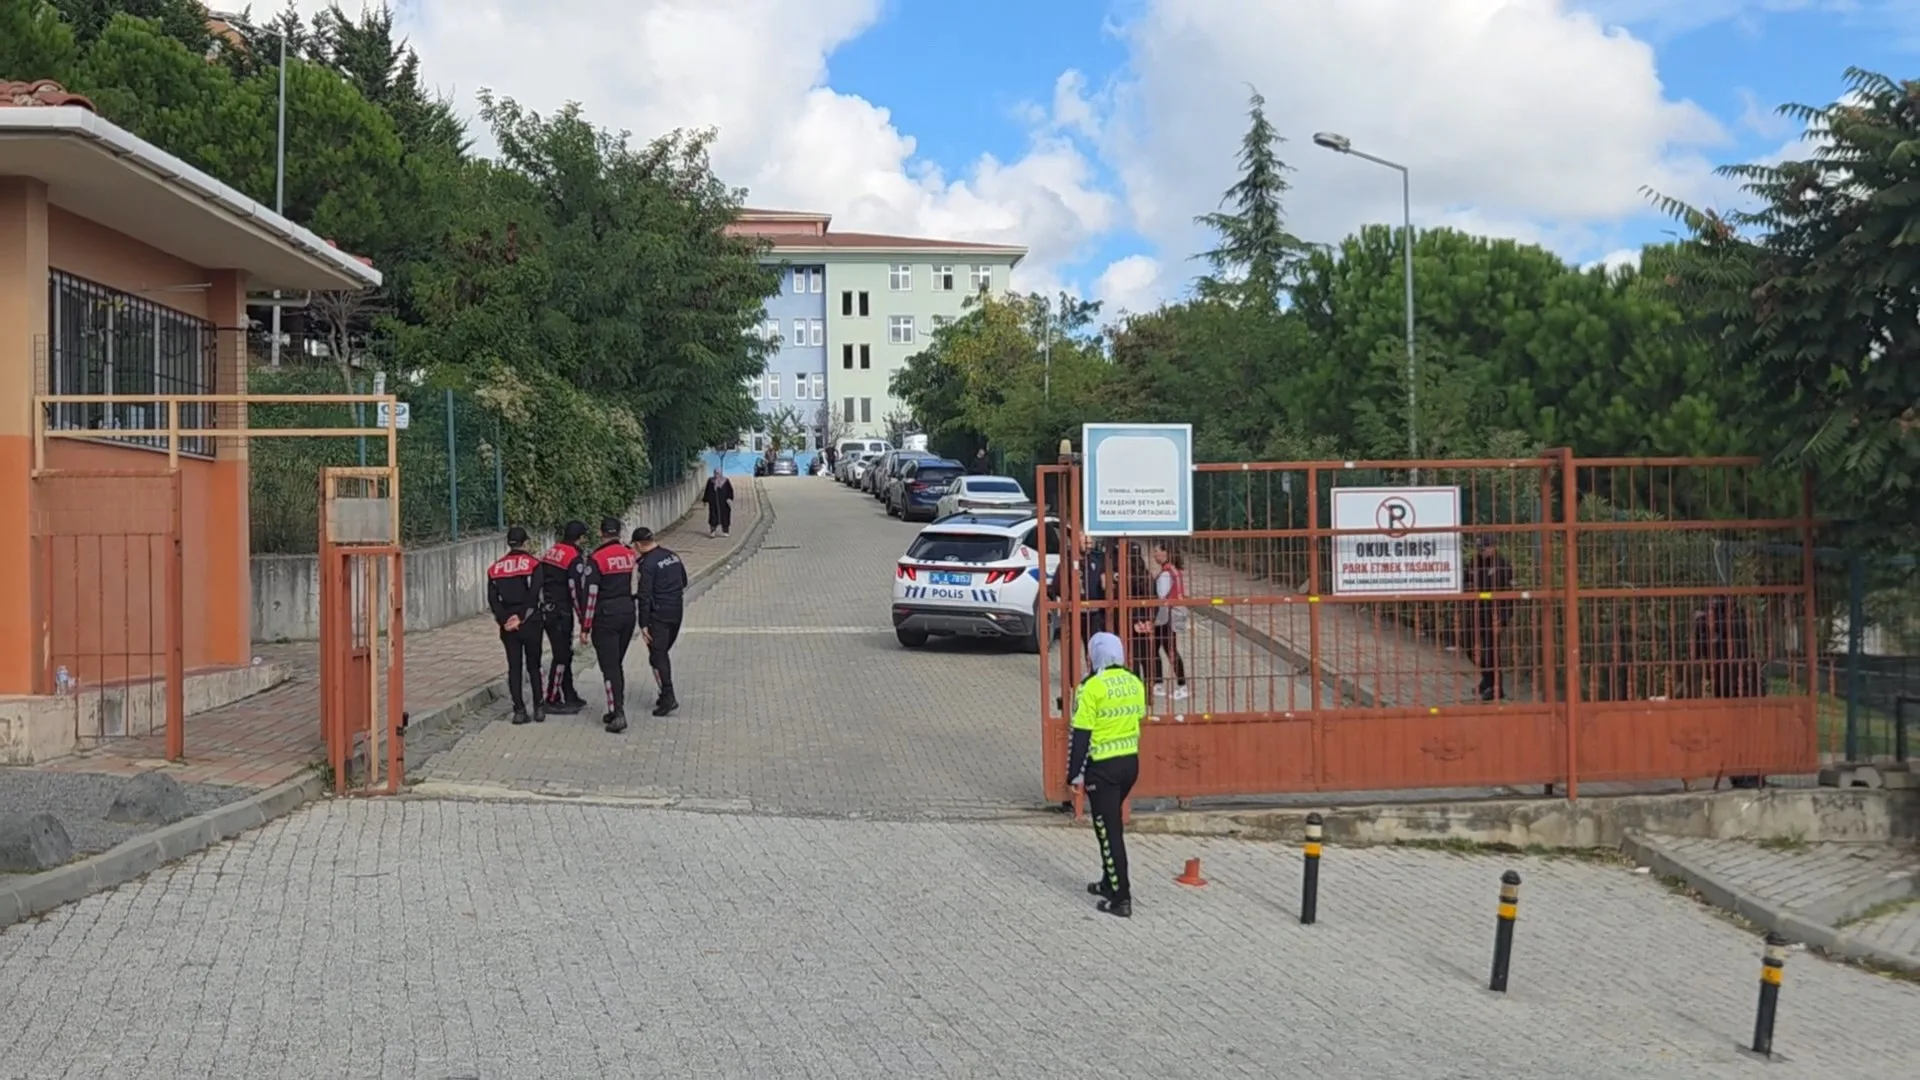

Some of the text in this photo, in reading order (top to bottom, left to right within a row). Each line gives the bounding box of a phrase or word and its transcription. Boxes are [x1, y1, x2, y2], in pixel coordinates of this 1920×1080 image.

[1356, 541, 1391, 558] OKUL
[1342, 563, 1369, 574] PARK
[1370, 562, 1401, 573] ETMEK
